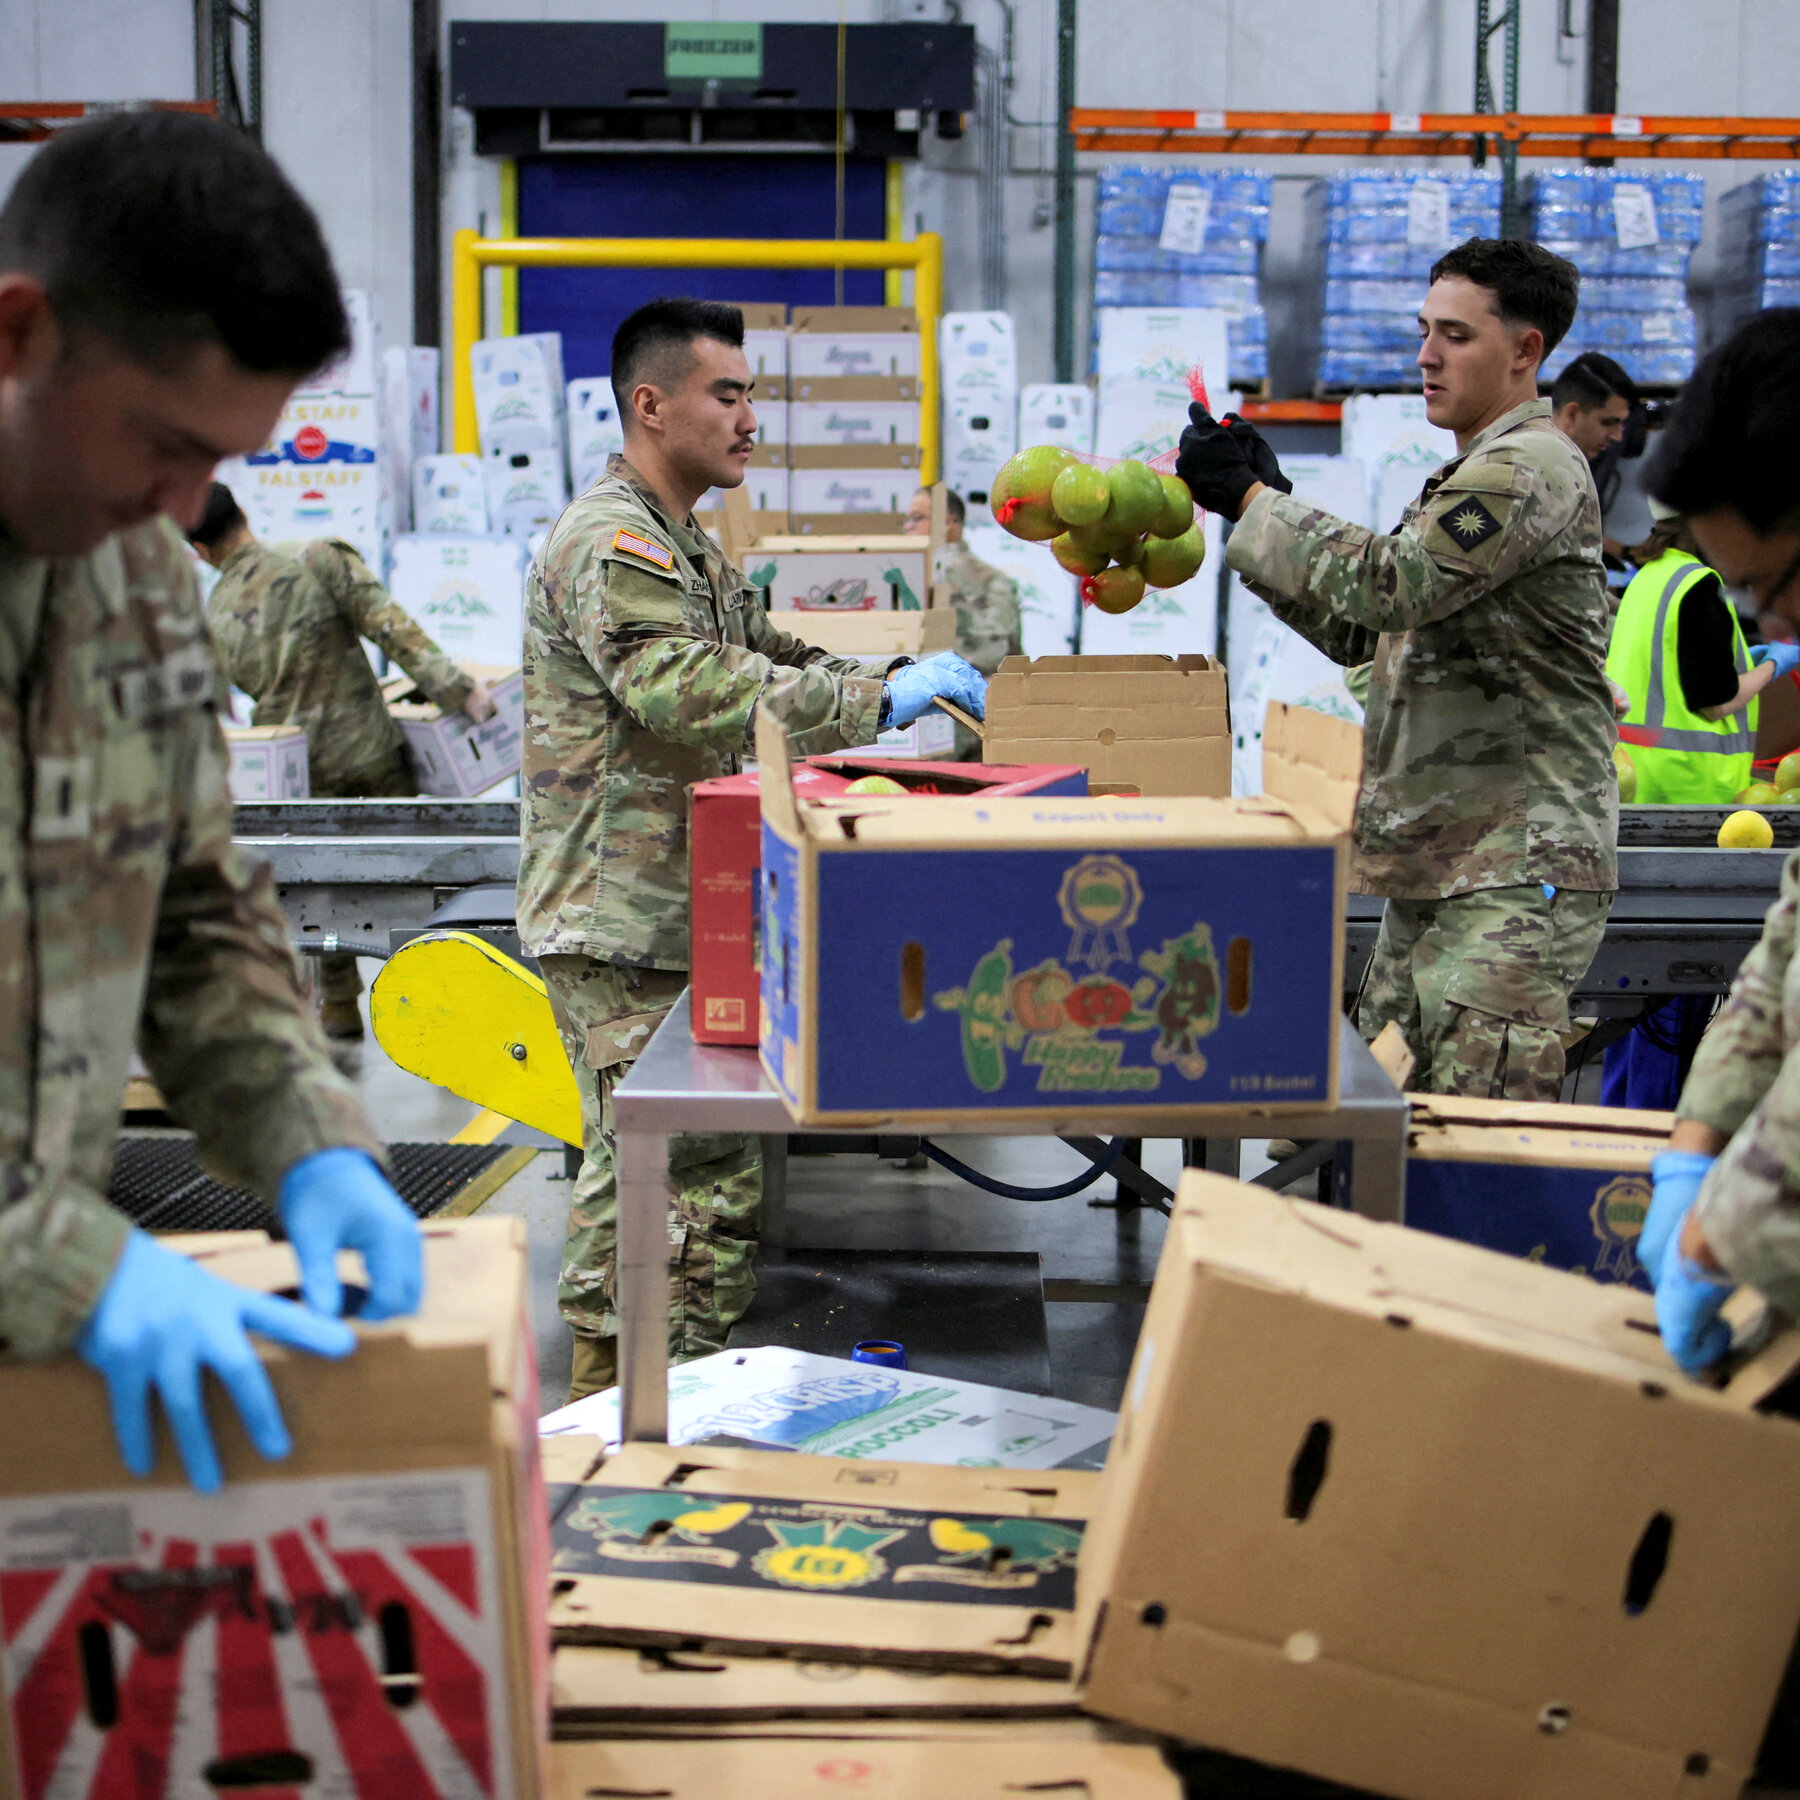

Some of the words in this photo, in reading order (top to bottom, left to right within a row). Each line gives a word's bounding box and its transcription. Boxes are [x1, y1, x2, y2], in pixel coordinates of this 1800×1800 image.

[669, 38, 755, 55] FREEZER
[258, 470, 363, 487] FALSTAFF
[835, 1408, 961, 1459] ROCCOLI
